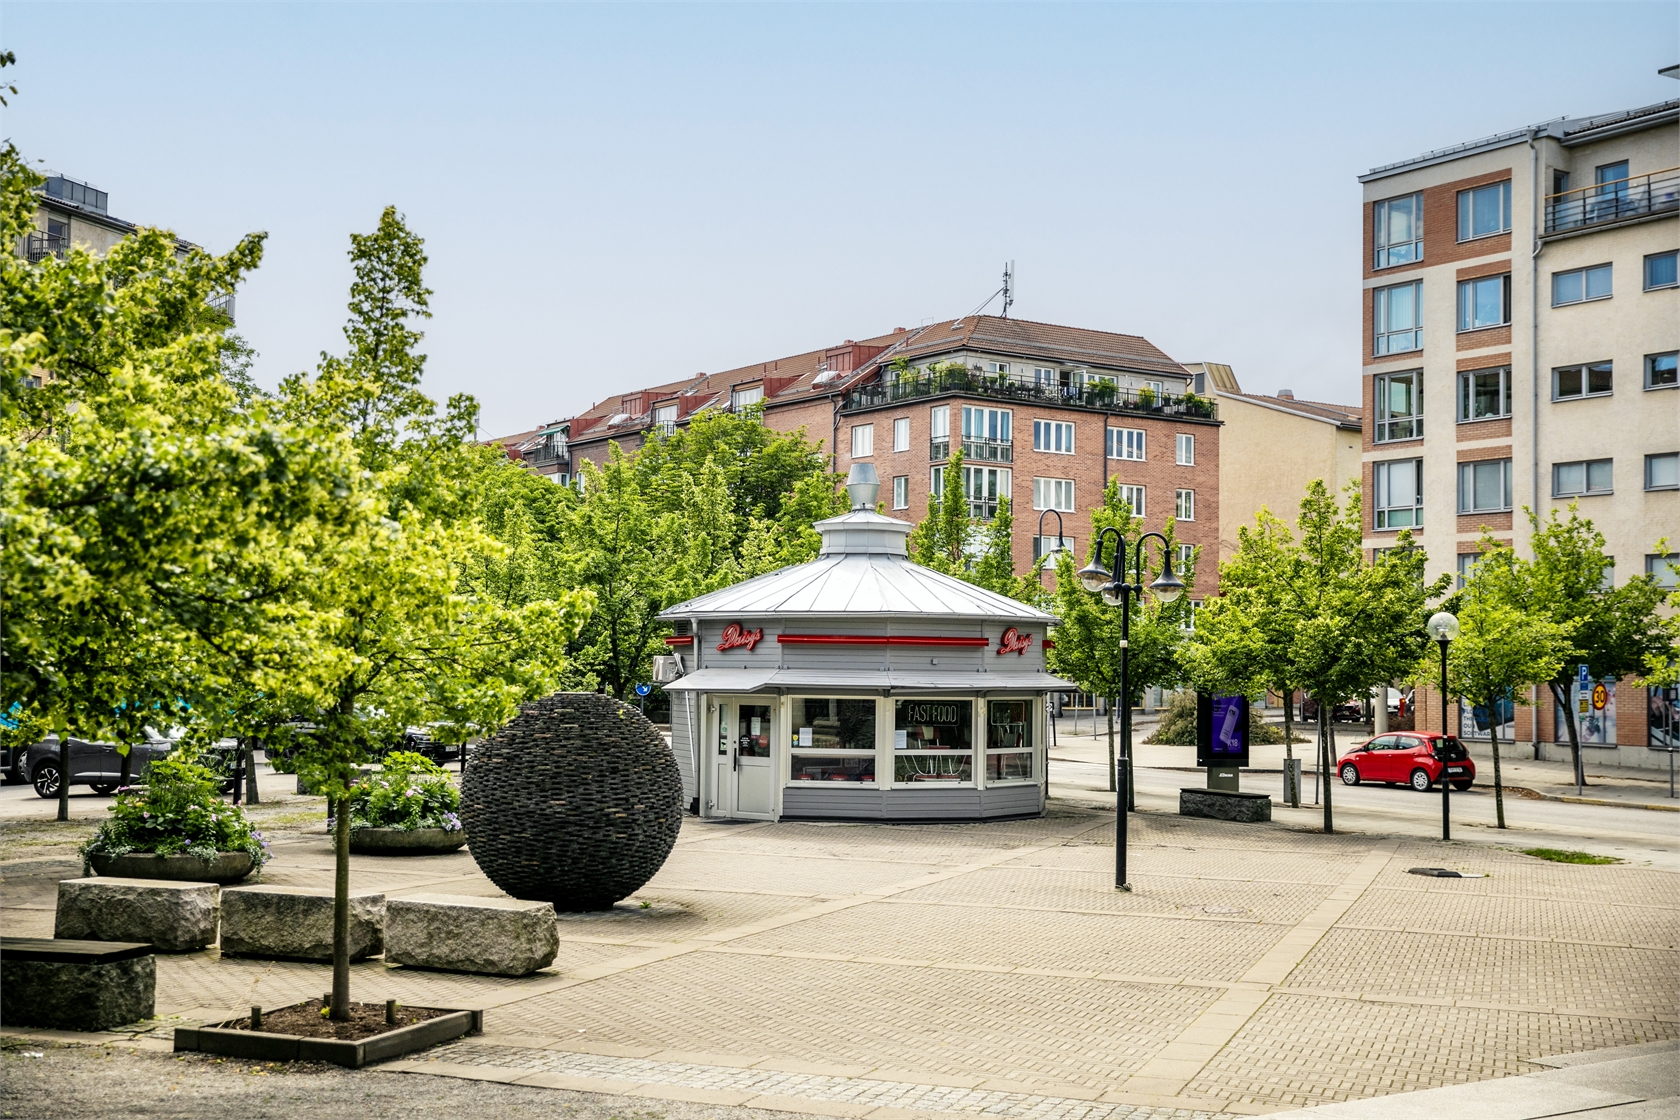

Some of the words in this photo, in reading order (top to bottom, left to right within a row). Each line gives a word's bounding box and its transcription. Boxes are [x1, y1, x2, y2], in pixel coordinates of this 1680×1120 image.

[1582, 667, 1587, 680] P
[1595, 690, 1605, 703] 30
[908, 704, 931, 722] FAST
[932, 705, 957, 722] FOOD
